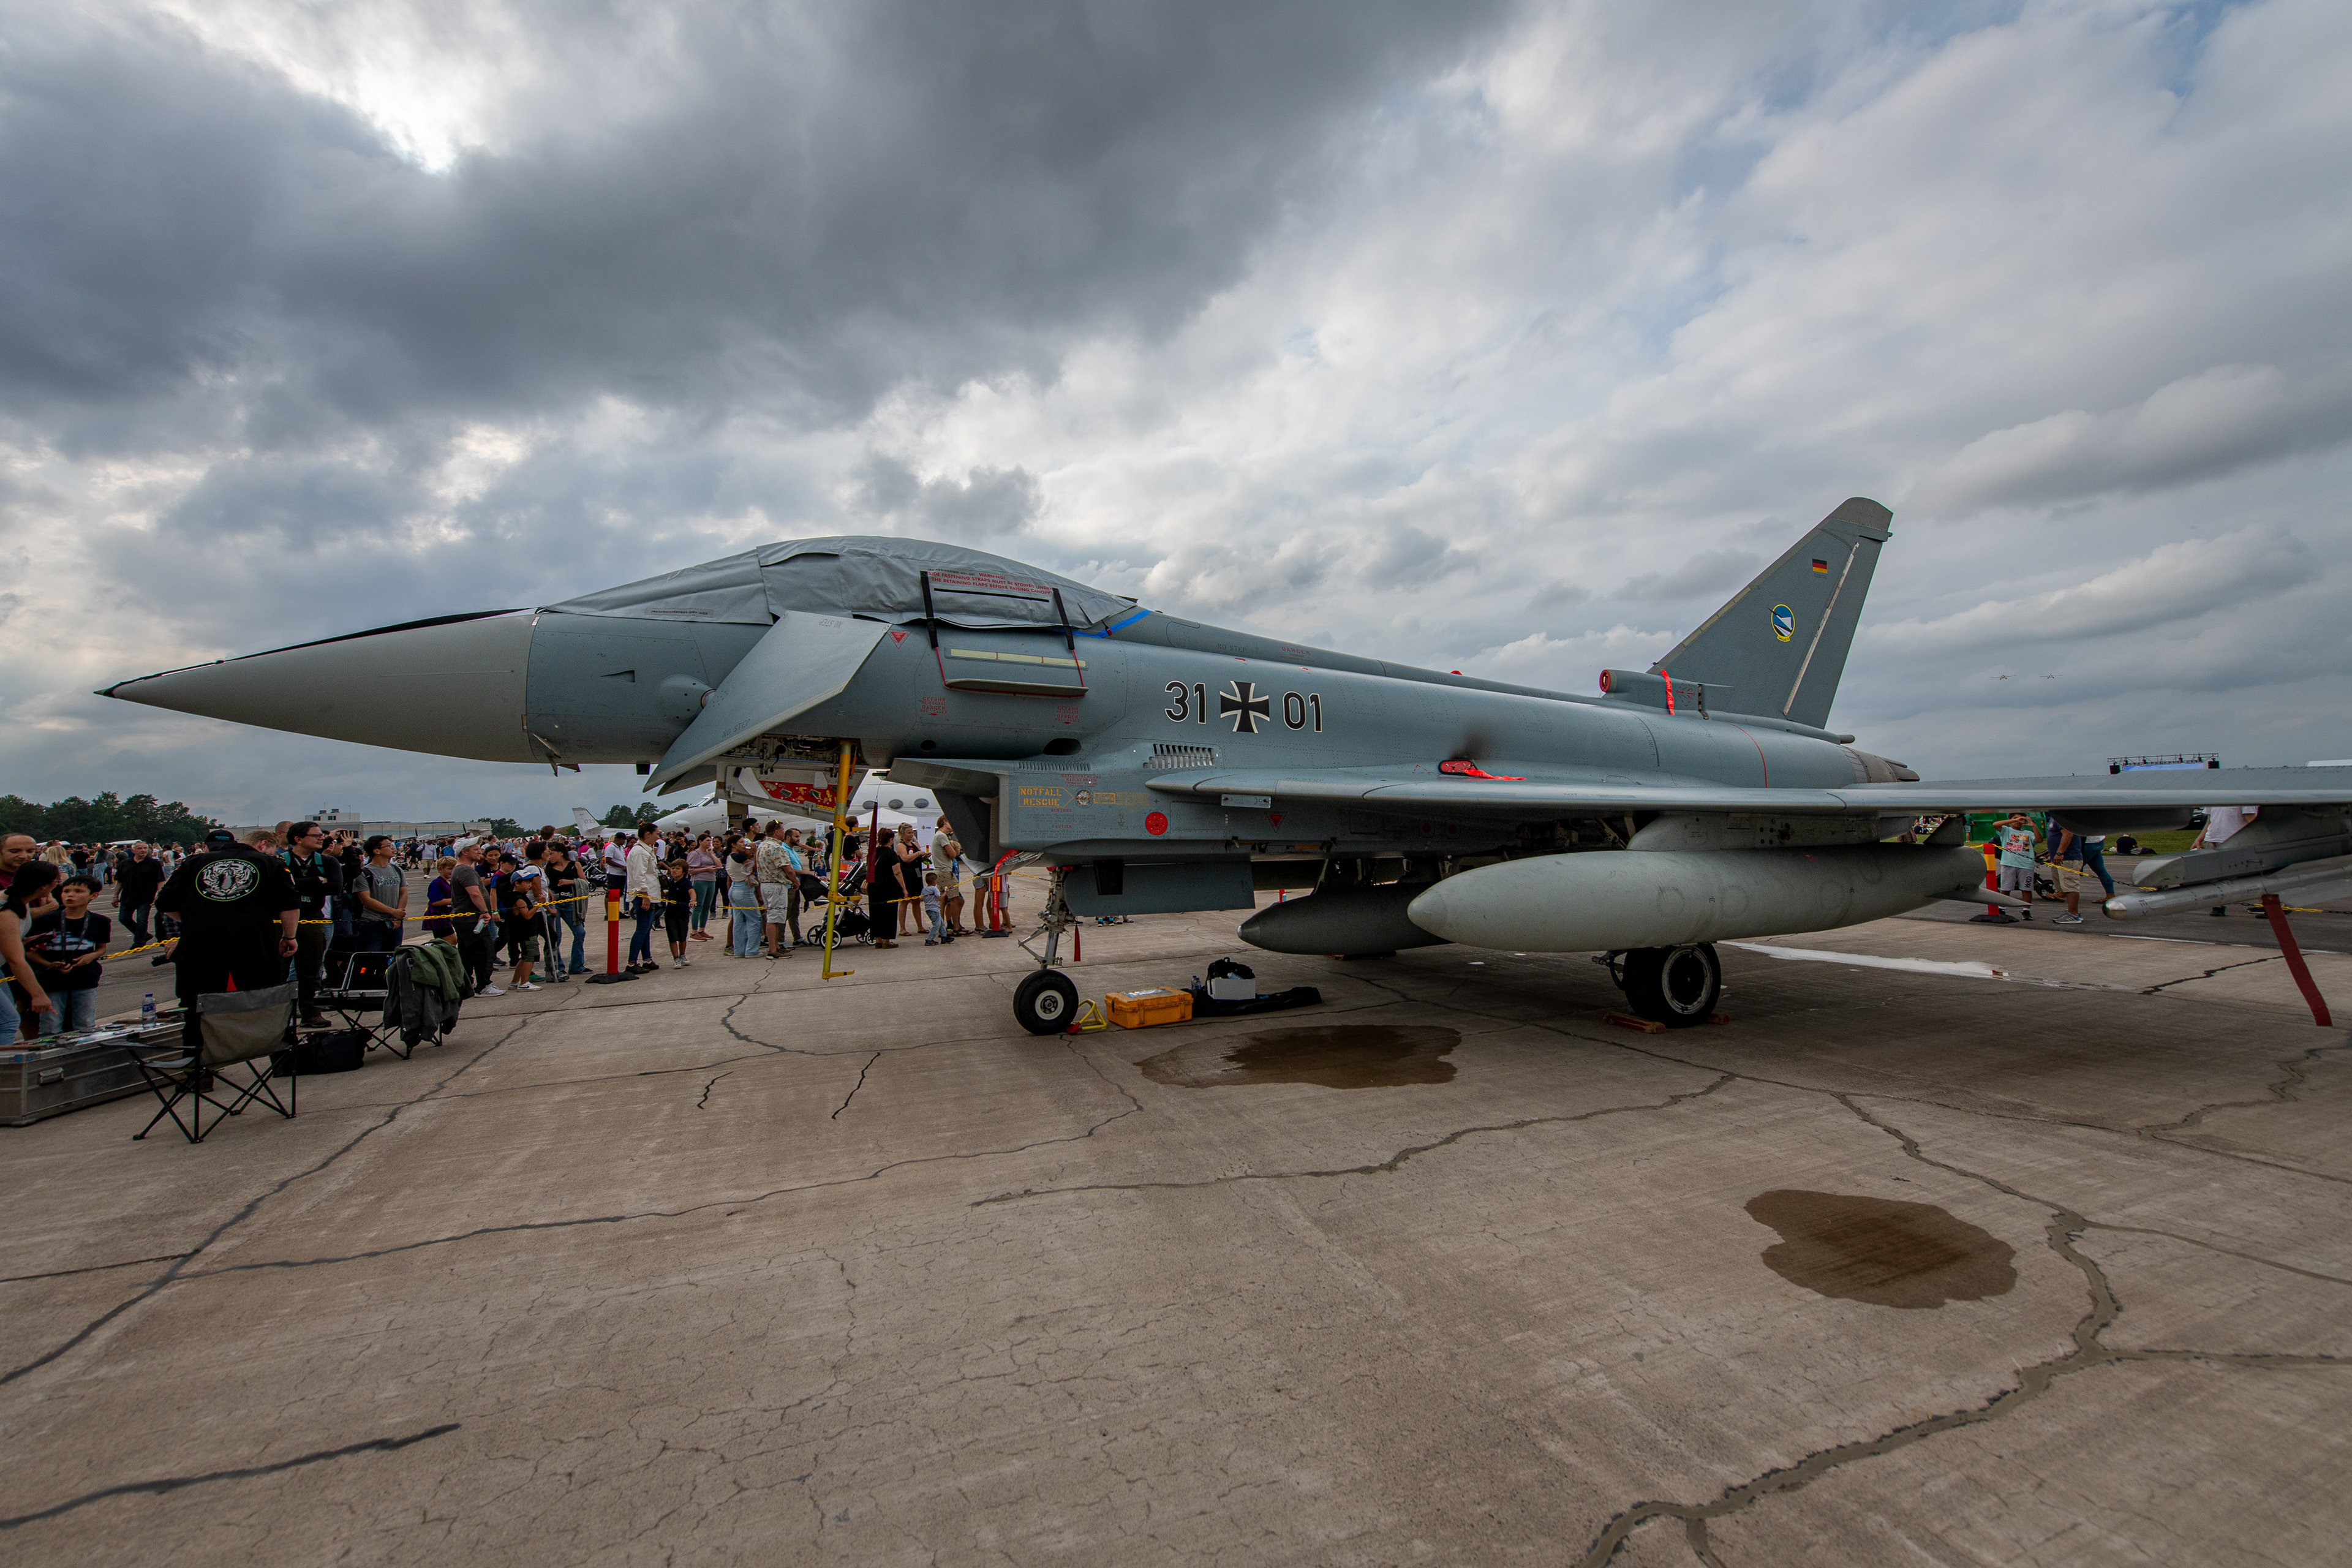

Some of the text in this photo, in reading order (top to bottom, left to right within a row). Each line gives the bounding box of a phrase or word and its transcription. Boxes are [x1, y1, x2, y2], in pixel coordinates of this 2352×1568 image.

[1229, 644, 1246, 653] STEP
[1281, 646, 1310, 655] DANGER
[1164, 680, 1322, 733] 31 01
[733, 718, 751, 733] STEP
[1646, 735, 1655, 750] LINE
[1020, 788, 1062, 797] NOTFALL
